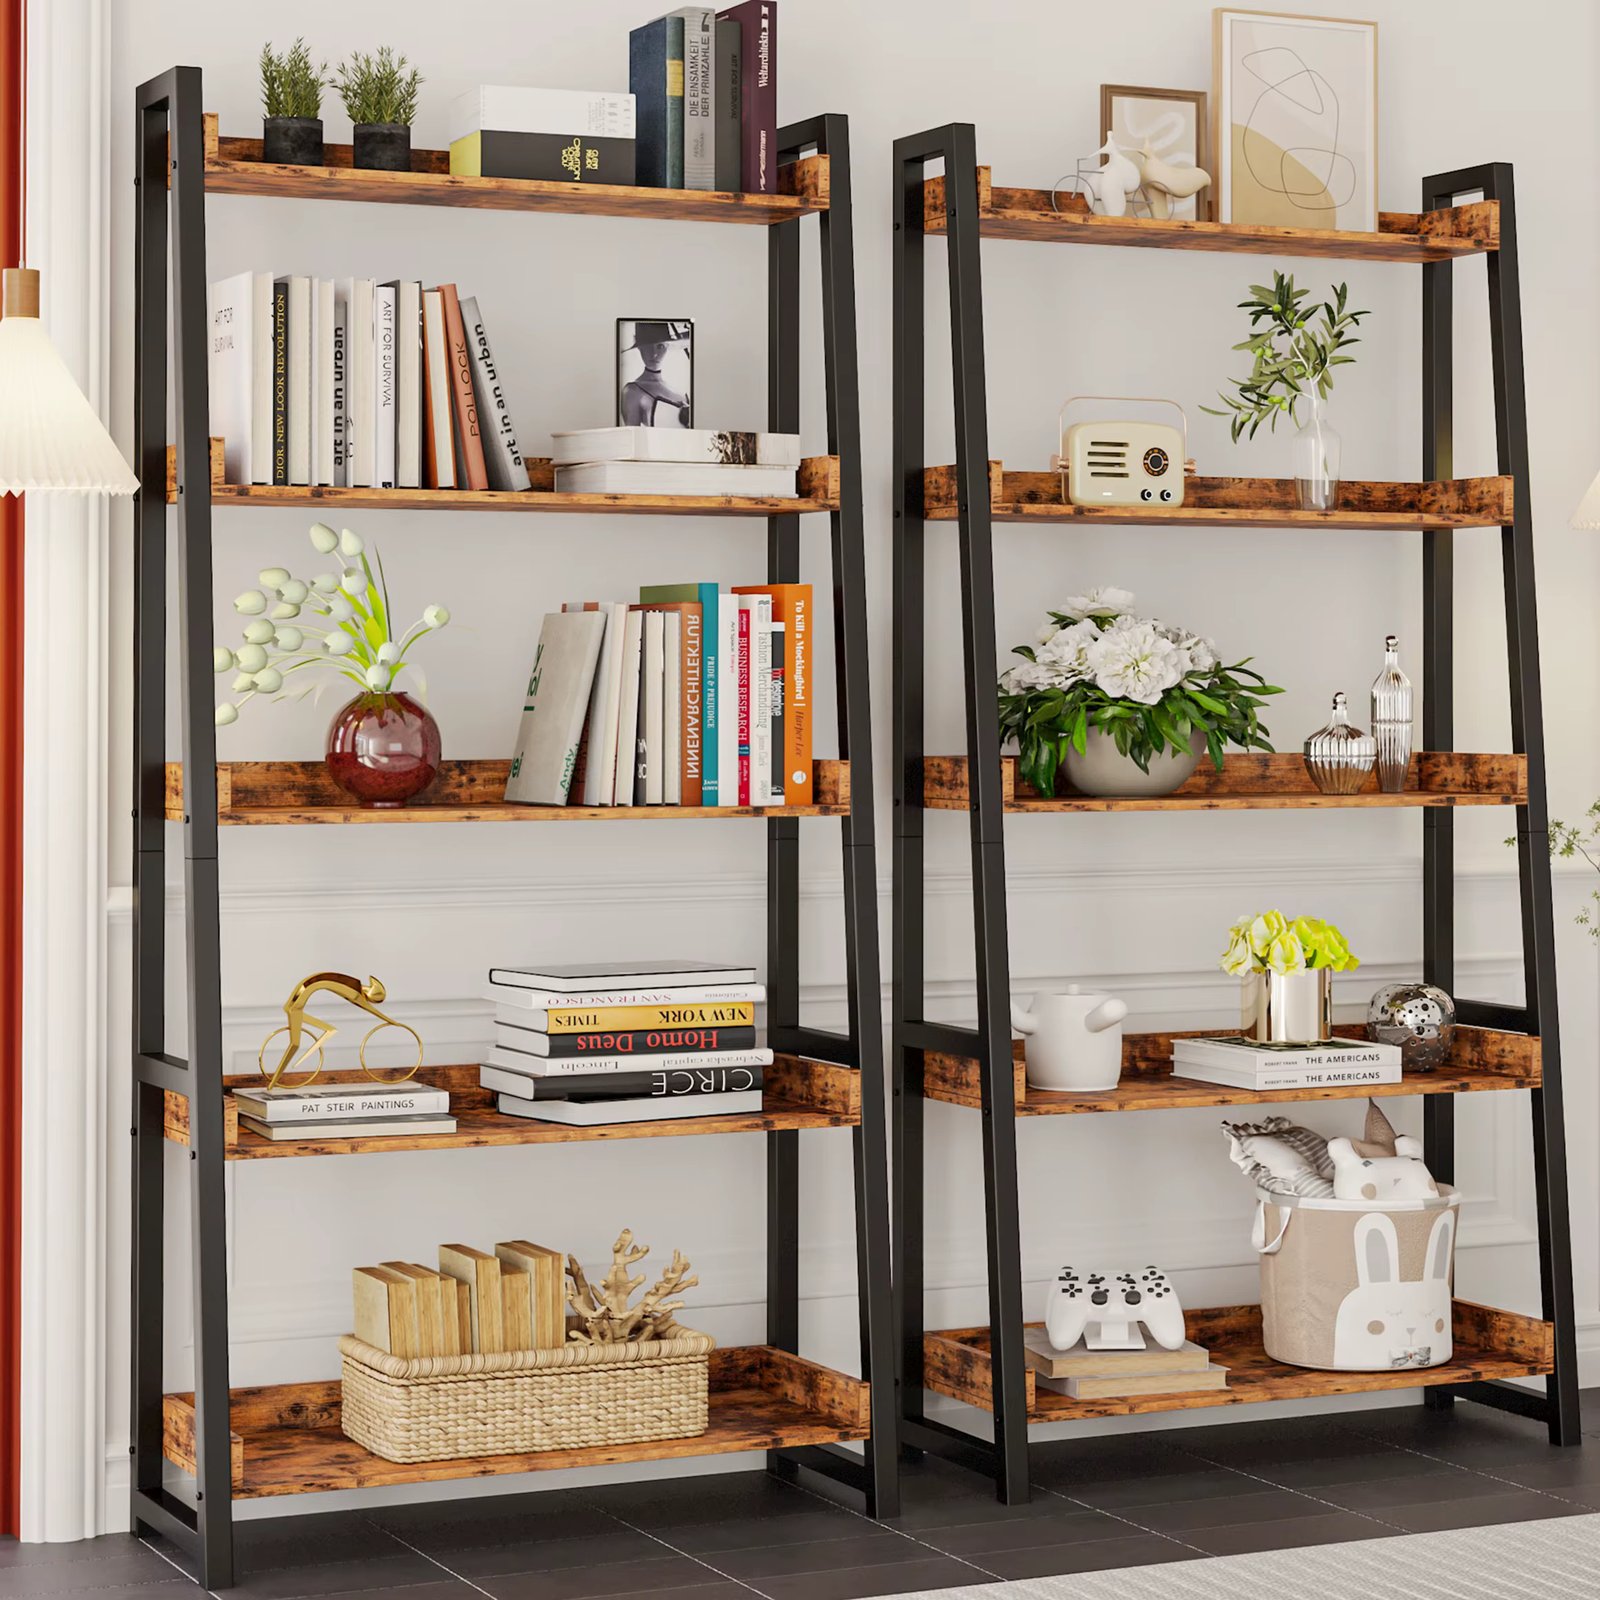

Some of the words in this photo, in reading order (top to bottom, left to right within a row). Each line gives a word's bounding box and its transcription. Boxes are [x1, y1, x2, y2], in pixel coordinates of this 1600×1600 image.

[689, 40, 699, 98] EINSAMKEIT
[689, 101, 699, 117] DIE
[701, 98, 710, 117] DER
[383, 301, 392, 323] ART
[276, 294, 285, 374] REVOLUTION
[383, 327, 392, 350] FOR
[334, 327, 343, 382] urban
[474, 323, 497, 381] urban
[383, 354, 392, 407] SURVIVAL
[276, 377, 285, 411] LOOK
[334, 388, 343, 410] an
[493, 386, 506, 409] an
[276, 414, 285, 443] NEW
[501, 414, 512, 435] in
[276, 446, 285, 479] DIOR.
[334, 440, 343, 466] art
[506, 439, 522, 466] art
[795, 600, 805, 612] To
[795, 614, 805, 631] Kill
[758, 632, 771, 664] Fashion
[707, 656, 715, 679] PRIDE
[738, 637, 748, 685] BUSINESS
[794, 640, 805, 700] Mockingbird
[707, 689, 715, 728] PREJUDICE
[757, 666, 772, 728] Merchandising
[738, 687, 748, 740] RESEARCH
[794, 711, 805, 740] Harper
[795, 743, 805, 757] Lee
[560, 748, 575, 789] Andy
[547, 995, 638, 1007] FRANCISCO
[642, 993, 671, 1003] SAN
[555, 1014, 599, 1027] TIMES
[658, 1009, 712, 1025] YORK
[712, 1007, 748, 1023] NEW
[577, 1033, 633, 1052] Deus
[646, 1030, 719, 1049] Homo
[561, 1060, 619, 1071] Lincoln
[1305, 1056, 1322, 1064] THE
[1326, 1053, 1380, 1063] AMERICANS
[651, 1068, 754, 1095] CIRCE
[1326, 1071, 1380, 1082] AMERICANS
[301, 1103, 320, 1113] PAT
[326, 1102, 355, 1112] STEIR
[361, 1099, 415, 1111] PAINTINGS
